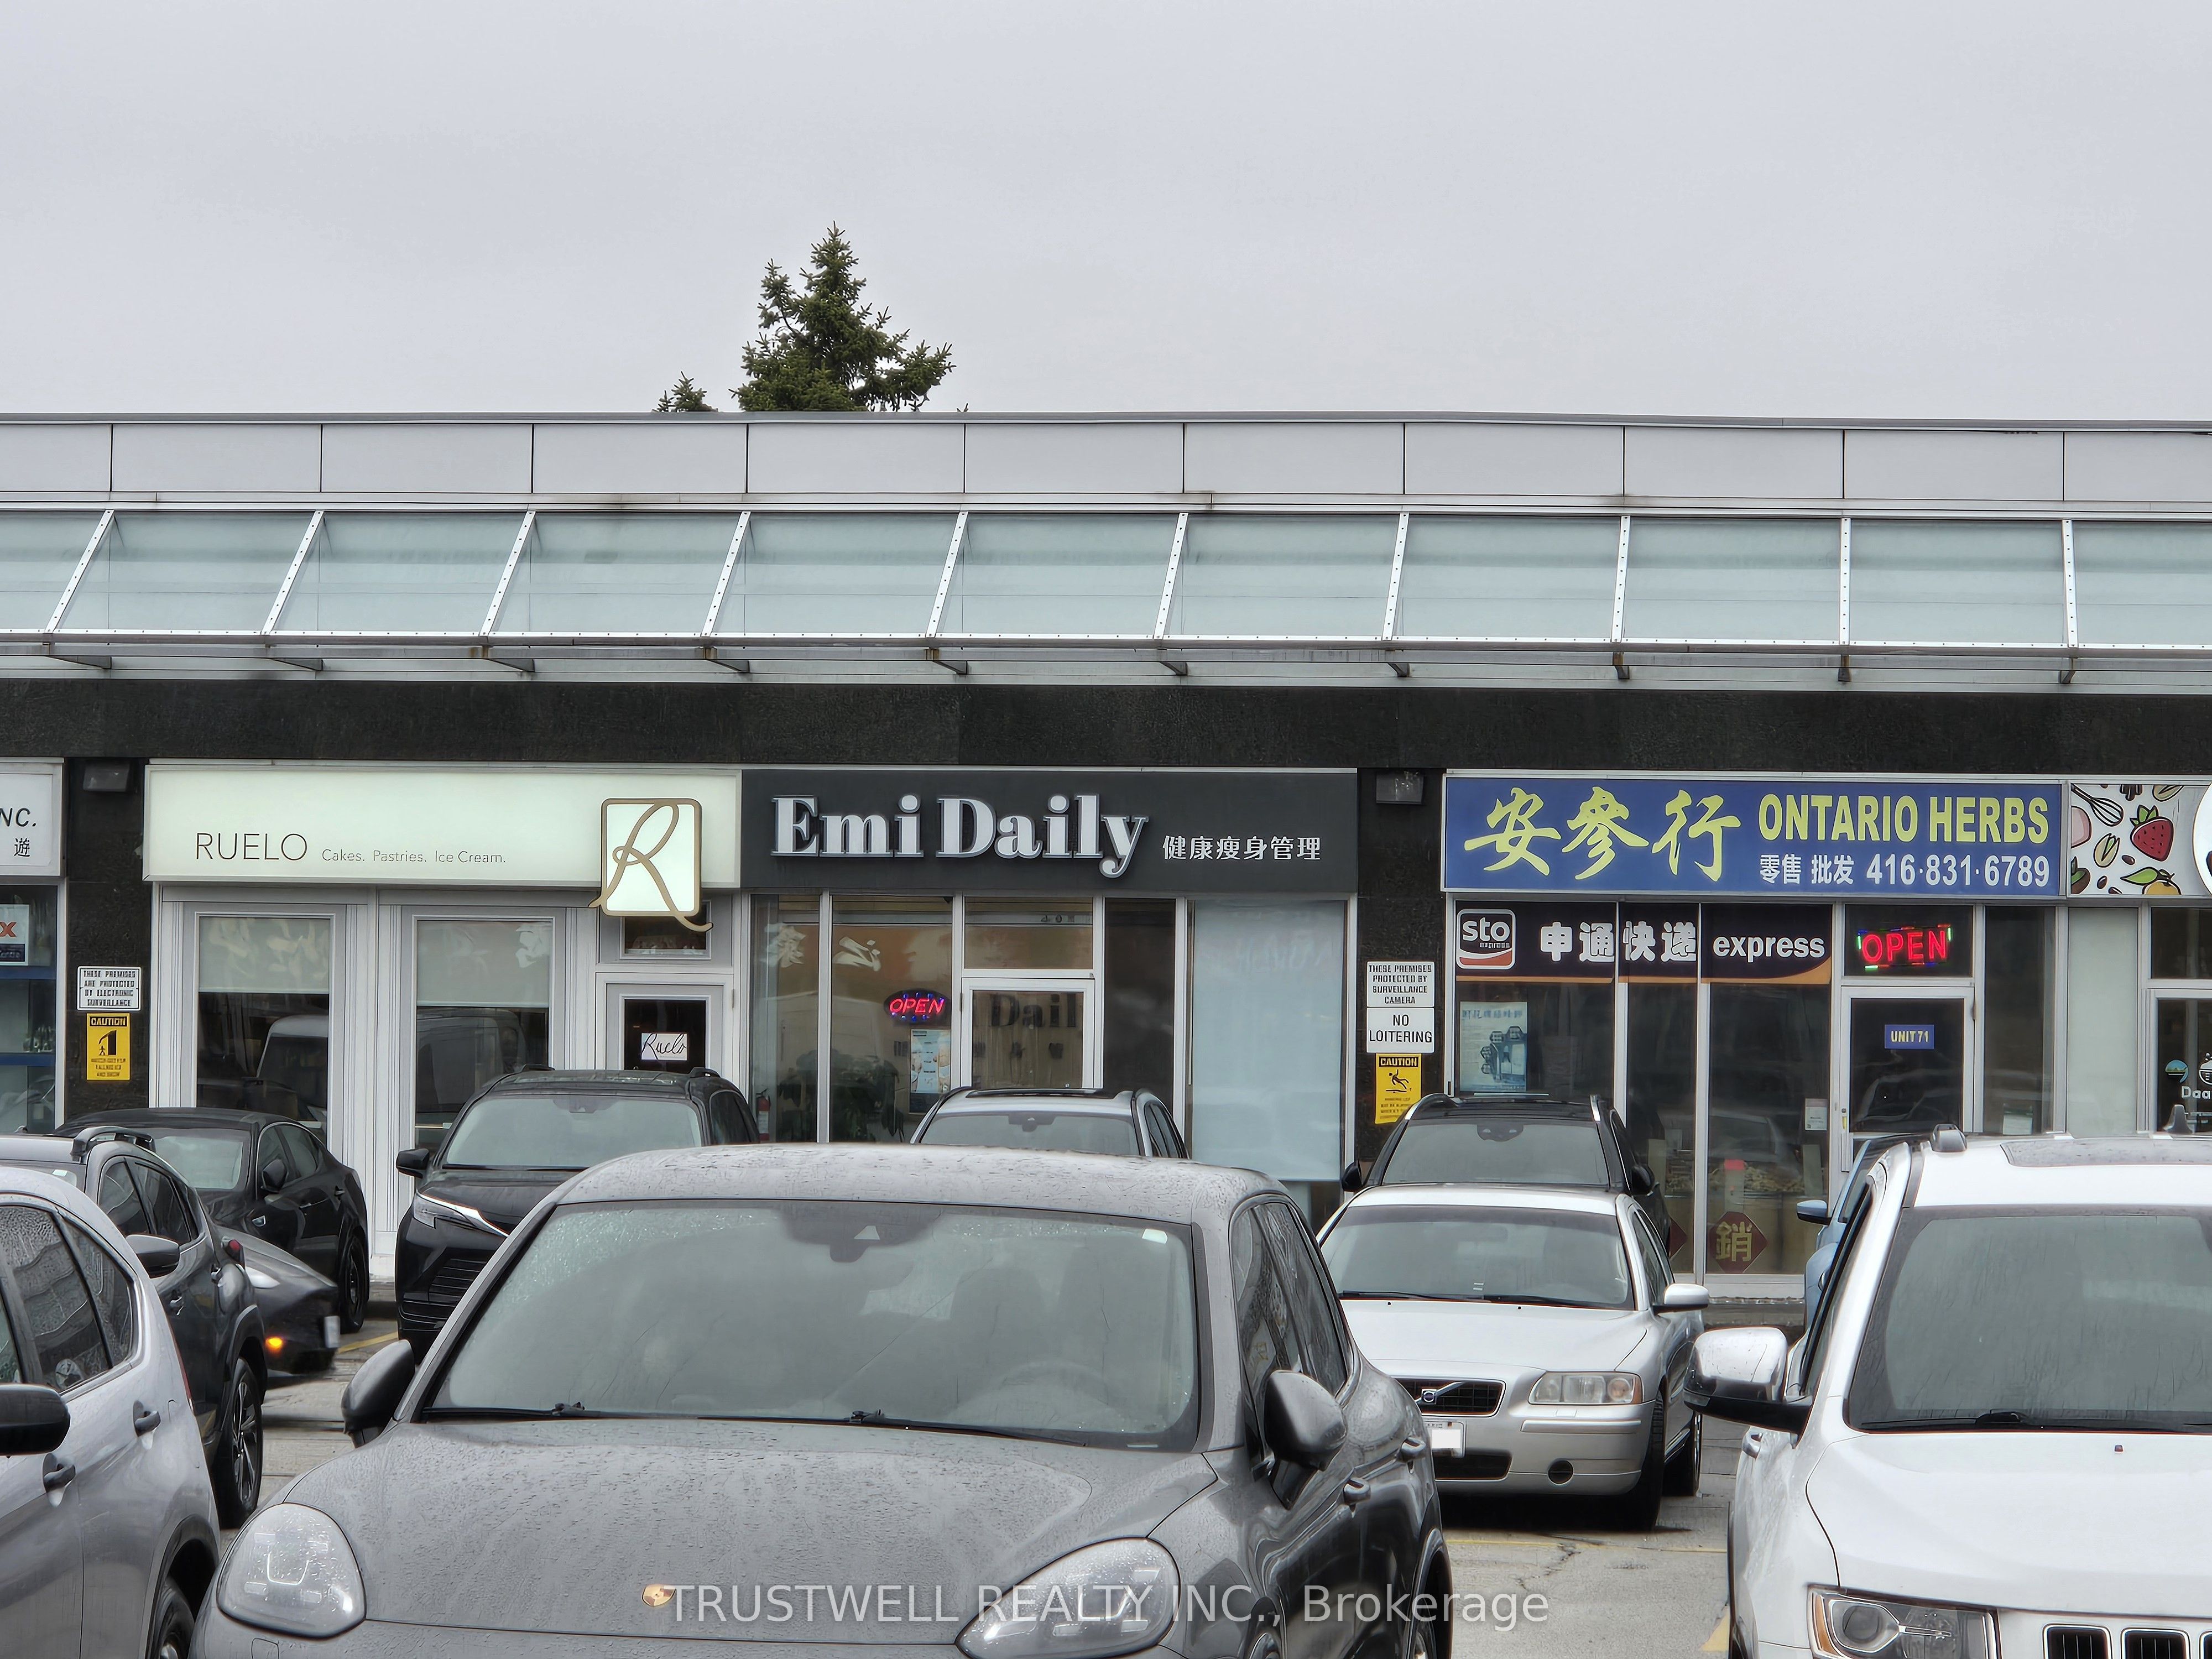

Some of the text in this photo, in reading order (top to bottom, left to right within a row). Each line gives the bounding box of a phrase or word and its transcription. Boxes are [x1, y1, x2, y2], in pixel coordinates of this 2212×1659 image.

[1759, 794, 2048, 844] ONTARIO HERBS
[196, 833, 307, 861] RUELO
[771, 794, 1149, 878] Emi Daily
[1162, 835, 1321, 860] 健康瘦身管理
[322, 848, 505, 863] Cakes. Pastries. Ice Cream.
[1760, 853, 1802, 884] 零售
[1811, 854, 1854, 884] 批发
[1463, 917, 1510, 942] sto
[1540, 921, 1697, 962] 申通快递
[1713, 936, 1825, 963] express
[1861, 930, 1947, 963] OPEN
[889, 998, 945, 1014] OPEN
[91, 1018, 126, 1026] CAUTION
[1392, 1014, 1410, 1026] NO
[1369, 1030, 1433, 1044] LOITERING
[1891, 1030, 1929, 1043] UNIT 71
[1380, 1057, 1417, 1067] CAUTION
[2181, 1086, 2212, 1100] Daa
